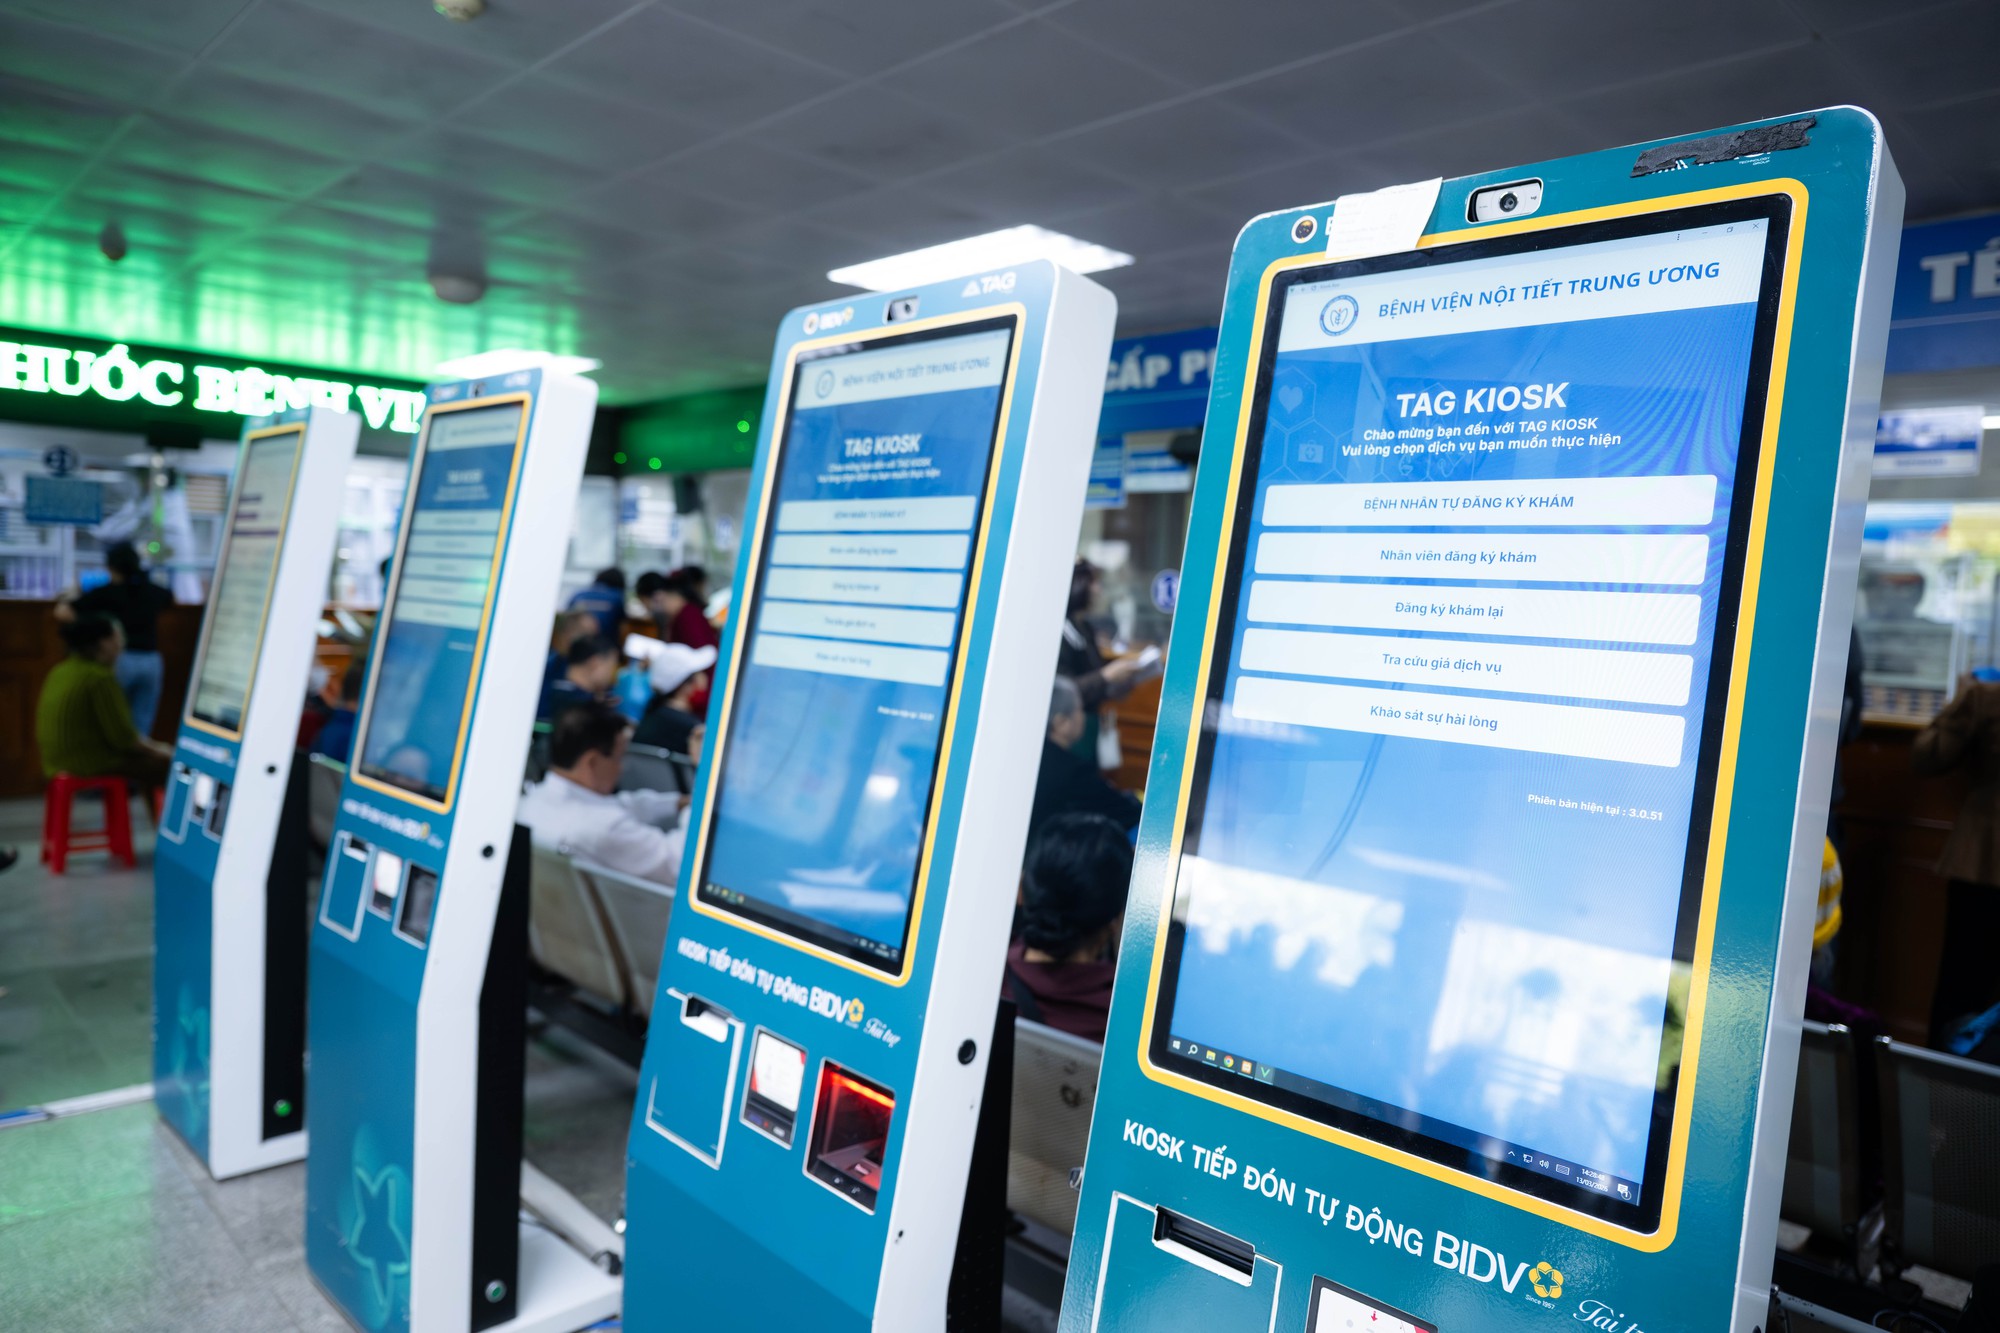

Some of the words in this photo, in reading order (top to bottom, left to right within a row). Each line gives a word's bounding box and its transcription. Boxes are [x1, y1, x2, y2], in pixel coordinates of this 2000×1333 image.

[980, 272, 1015, 294] TAG
[1378, 299, 1425, 319] BỆNH
[1432, 291, 1473, 313] VIỆN
[1479, 285, 1515, 307] NỘI
[1522, 278, 1563, 299] TIẾT
[1568, 272, 1641, 292] TRUNG
[1648, 262, 1720, 285] ƯƠNG
[1396, 390, 1456, 418] TAG
[1464, 382, 1570, 414] KIOSK
[1363, 428, 1395, 441] Chào
[1398, 425, 1434, 442] mừng
[1437, 424, 1461, 439] bạn
[1464, 420, 1490, 436] đến
[1494, 420, 1515, 434] với
[1519, 420, 1547, 433] TAG
[1551, 417, 1598, 431] KIOSK
[844, 437, 873, 457] TAG
[873, 433, 922, 455] KIOSK
[1341, 444, 1361, 457] Vui
[1364, 443, 1390, 458] lòng
[1393, 441, 1425, 456] chọn
[1427, 440, 1456, 455] dịch
[1459, 442, 1476, 454] vụ
[1479, 438, 1504, 453] bạn
[1508, 433, 1548, 450] muốn
[1551, 434, 1585, 449] thực
[1588, 432, 1621, 447] hiện
[1364, 497, 1397, 512] BỆNH
[1400, 496, 1438, 510] NHÂN
[1442, 496, 1460, 512] TỰ
[1462, 494, 1502, 509] ĐĂNG
[1505, 494, 1526, 508] KÝ
[1529, 493, 1574, 508] KHÁM
[1380, 549, 1412, 561] Nhân
[1415, 550, 1442, 562] viên
[1444, 550, 1476, 564] đăng
[1480, 550, 1496, 565] ký
[1500, 551, 1537, 563] khám
[1395, 602, 1427, 616] Đăng
[1430, 603, 1445, 617] ký
[1449, 604, 1484, 617] khám
[1488, 605, 1504, 620] lại
[1382, 653, 1400, 665] Tra
[1404, 655, 1428, 667] cứu
[1431, 657, 1450, 671] giá
[1453, 658, 1481, 673] dịch
[1485, 663, 1502, 676] vụ
[1370, 705, 1401, 719] Khảo
[1404, 709, 1423, 721] sát
[1427, 712, 1443, 726] sự
[1445, 712, 1466, 726] hài
[1469, 714, 1498, 732] lòng
[1528, 794, 1556, 806] Phiên
[1558, 798, 1578, 809] bản
[1580, 801, 1603, 814] hiện
[1605, 805, 1620, 816] tại
[1628, 808, 1663, 821] 3.0.51
[808, 986, 849, 1023] BIDV
[1123, 1119, 1185, 1163] KIOSK
[1192, 1145, 1237, 1180] TIẾP
[1243, 1168, 1296, 1206] ĐÓN
[1305, 1188, 1340, 1226] TỰ
[1345, 1204, 1424, 1257] ĐỘNG
[1433, 1230, 1531, 1294] BIDV
[1524, 1294, 1541, 1305] Since
[1573, 1299, 1625, 1333] Tài
